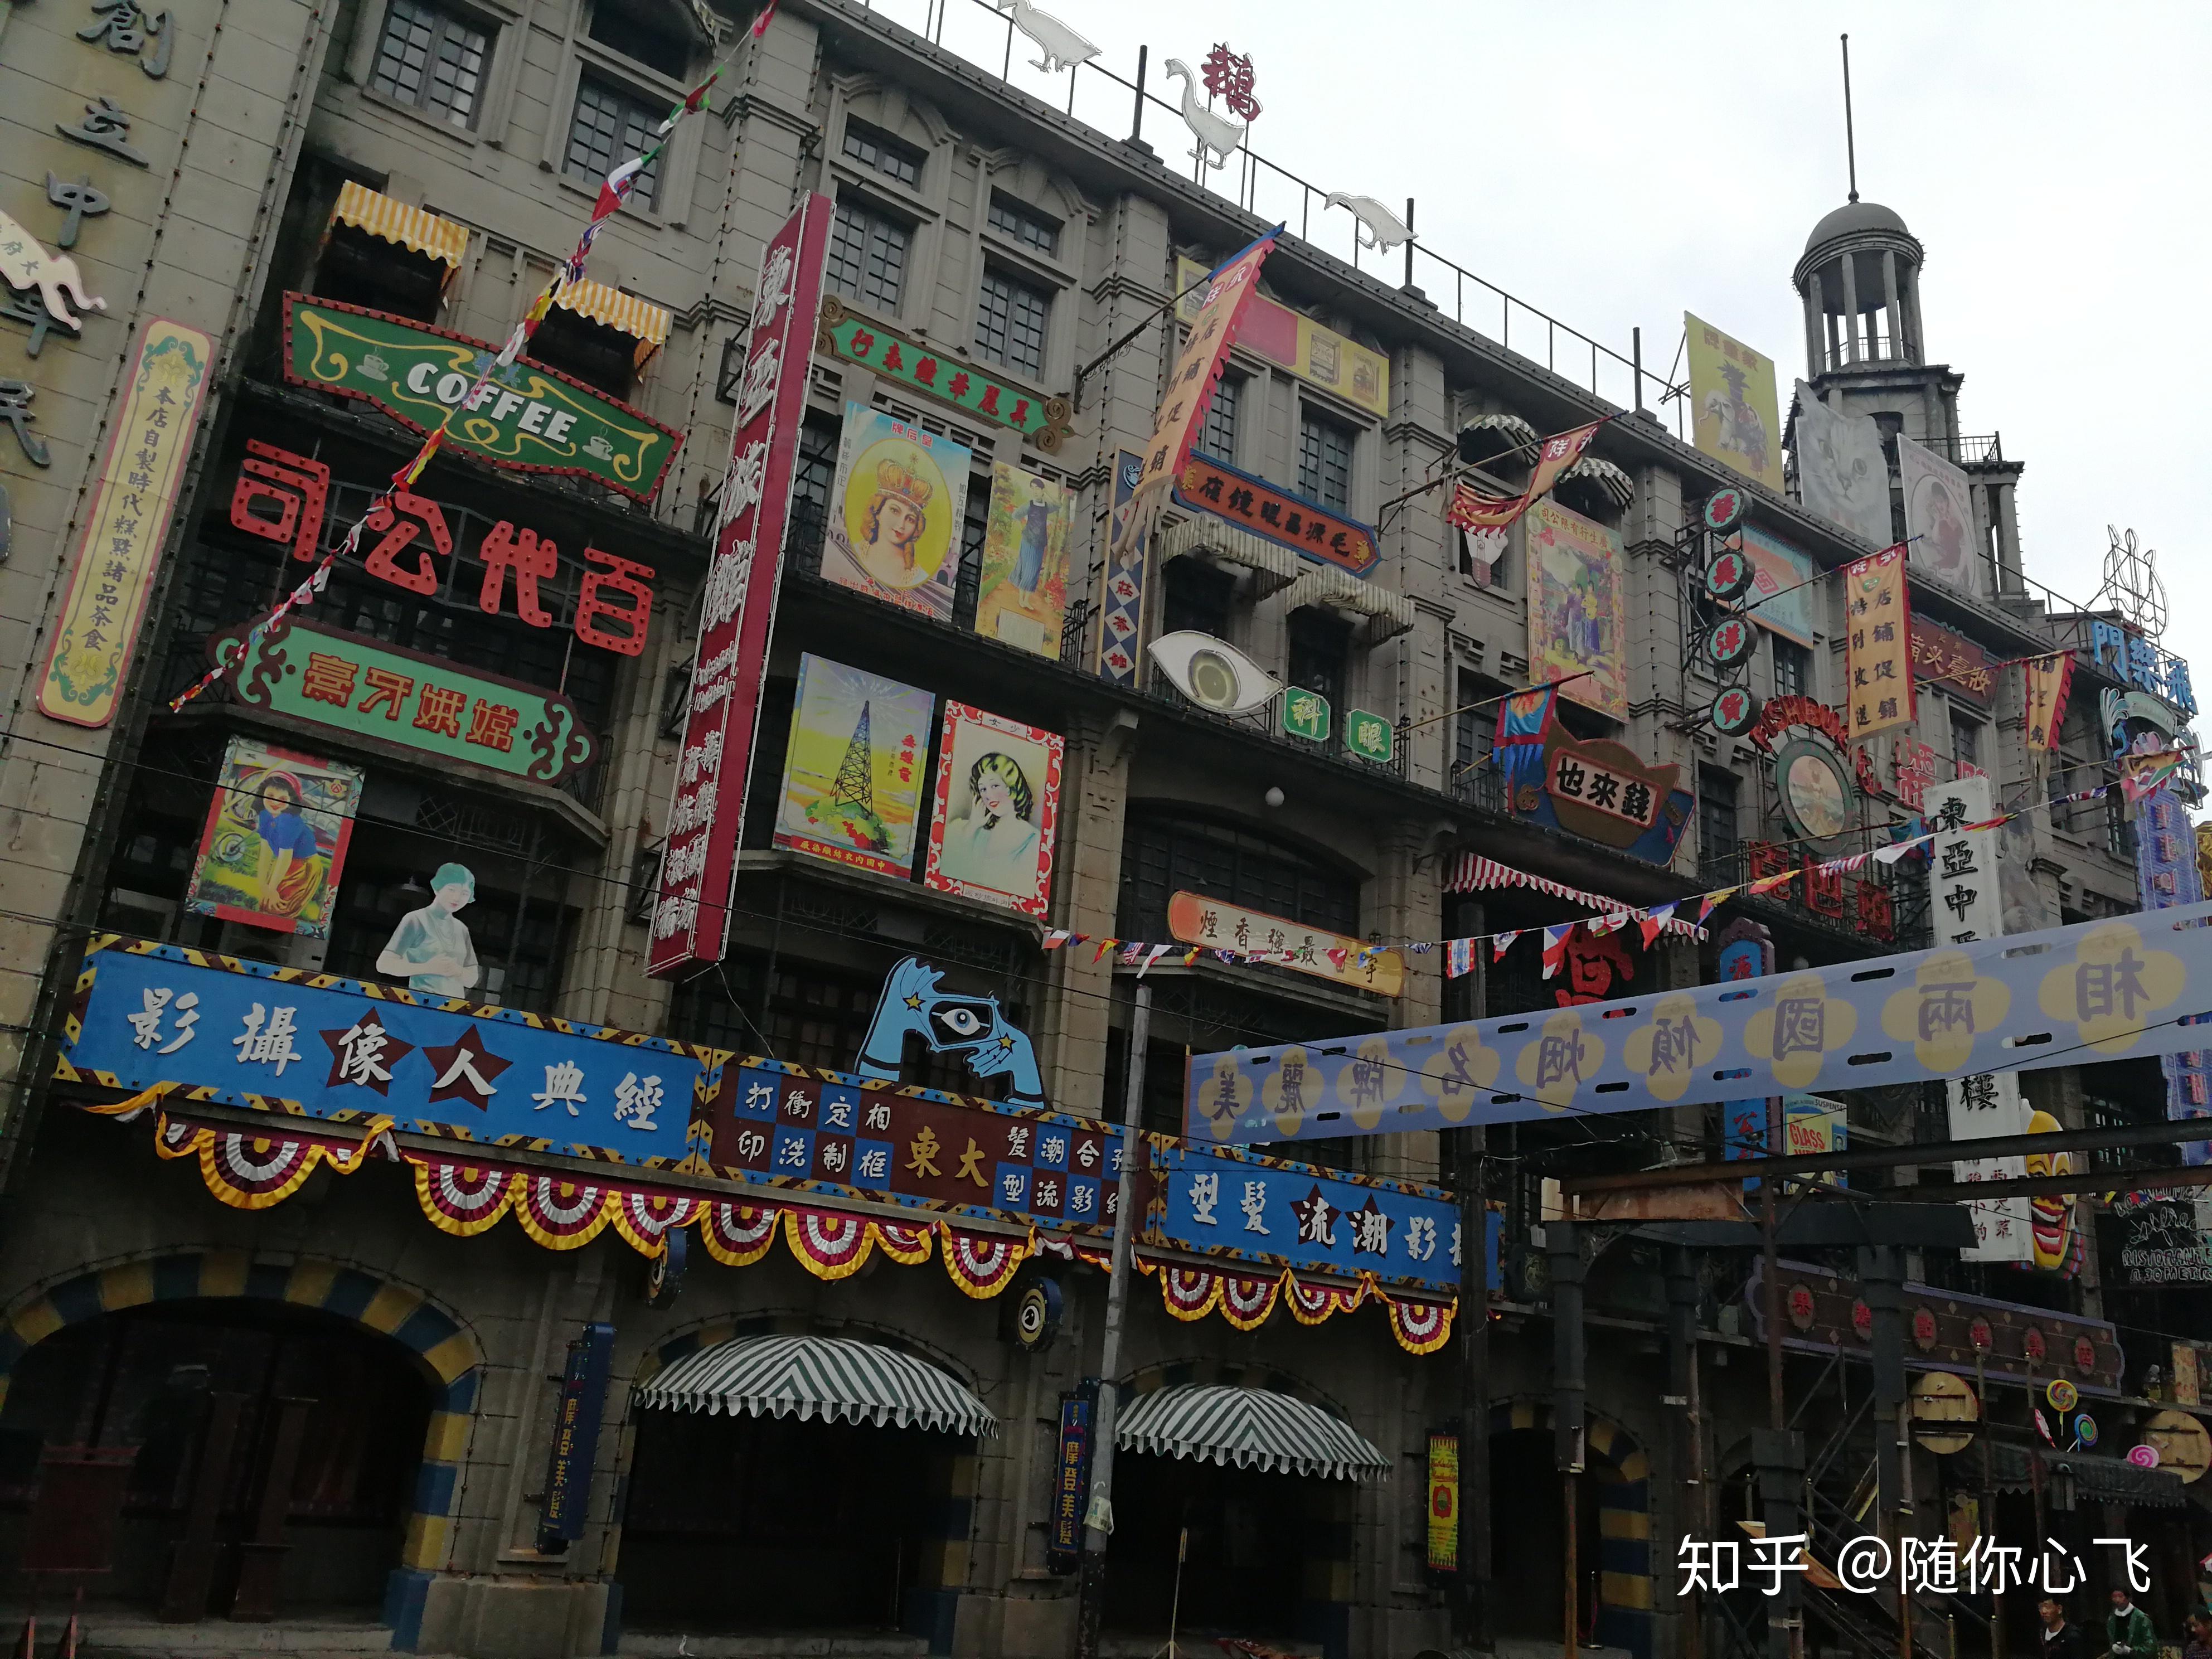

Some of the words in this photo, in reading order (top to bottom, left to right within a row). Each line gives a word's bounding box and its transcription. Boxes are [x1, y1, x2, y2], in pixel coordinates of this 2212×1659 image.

[407, 363, 578, 444] COFFEE
[230, 439, 655, 657] 百代公司
[302, 652, 519, 753] 嫦娥牙膏
[1292, 696, 1385, 754] 眼科
[1556, 757, 1651, 822] 錢來也
[128, 987, 662, 1132] 經典人像攝影
[1788, 1123, 1826, 1150] GLASS
